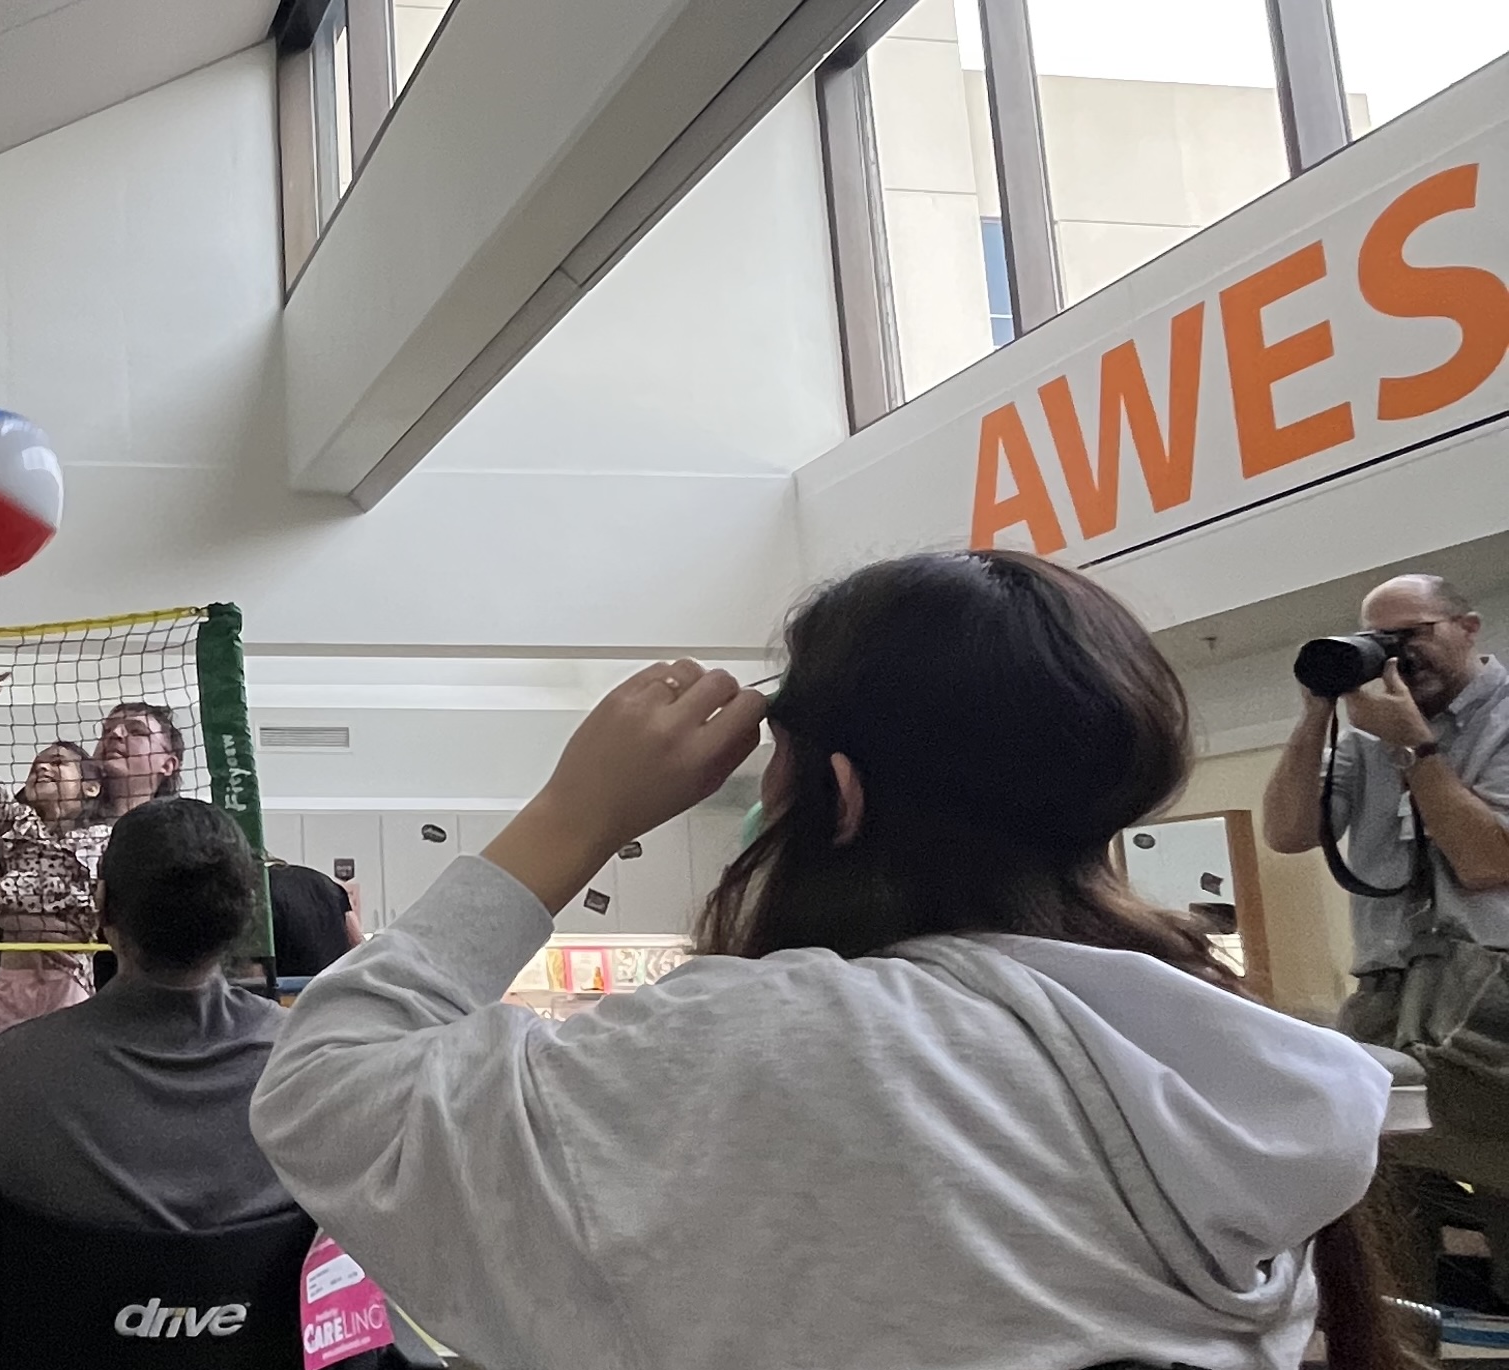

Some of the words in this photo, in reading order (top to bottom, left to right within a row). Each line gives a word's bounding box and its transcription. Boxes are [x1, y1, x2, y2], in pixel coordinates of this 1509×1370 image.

[970, 162, 1509, 556] AWES
[114, 1298, 247, 1338] drive
[304, 1304, 384, 1354] CARELINC
